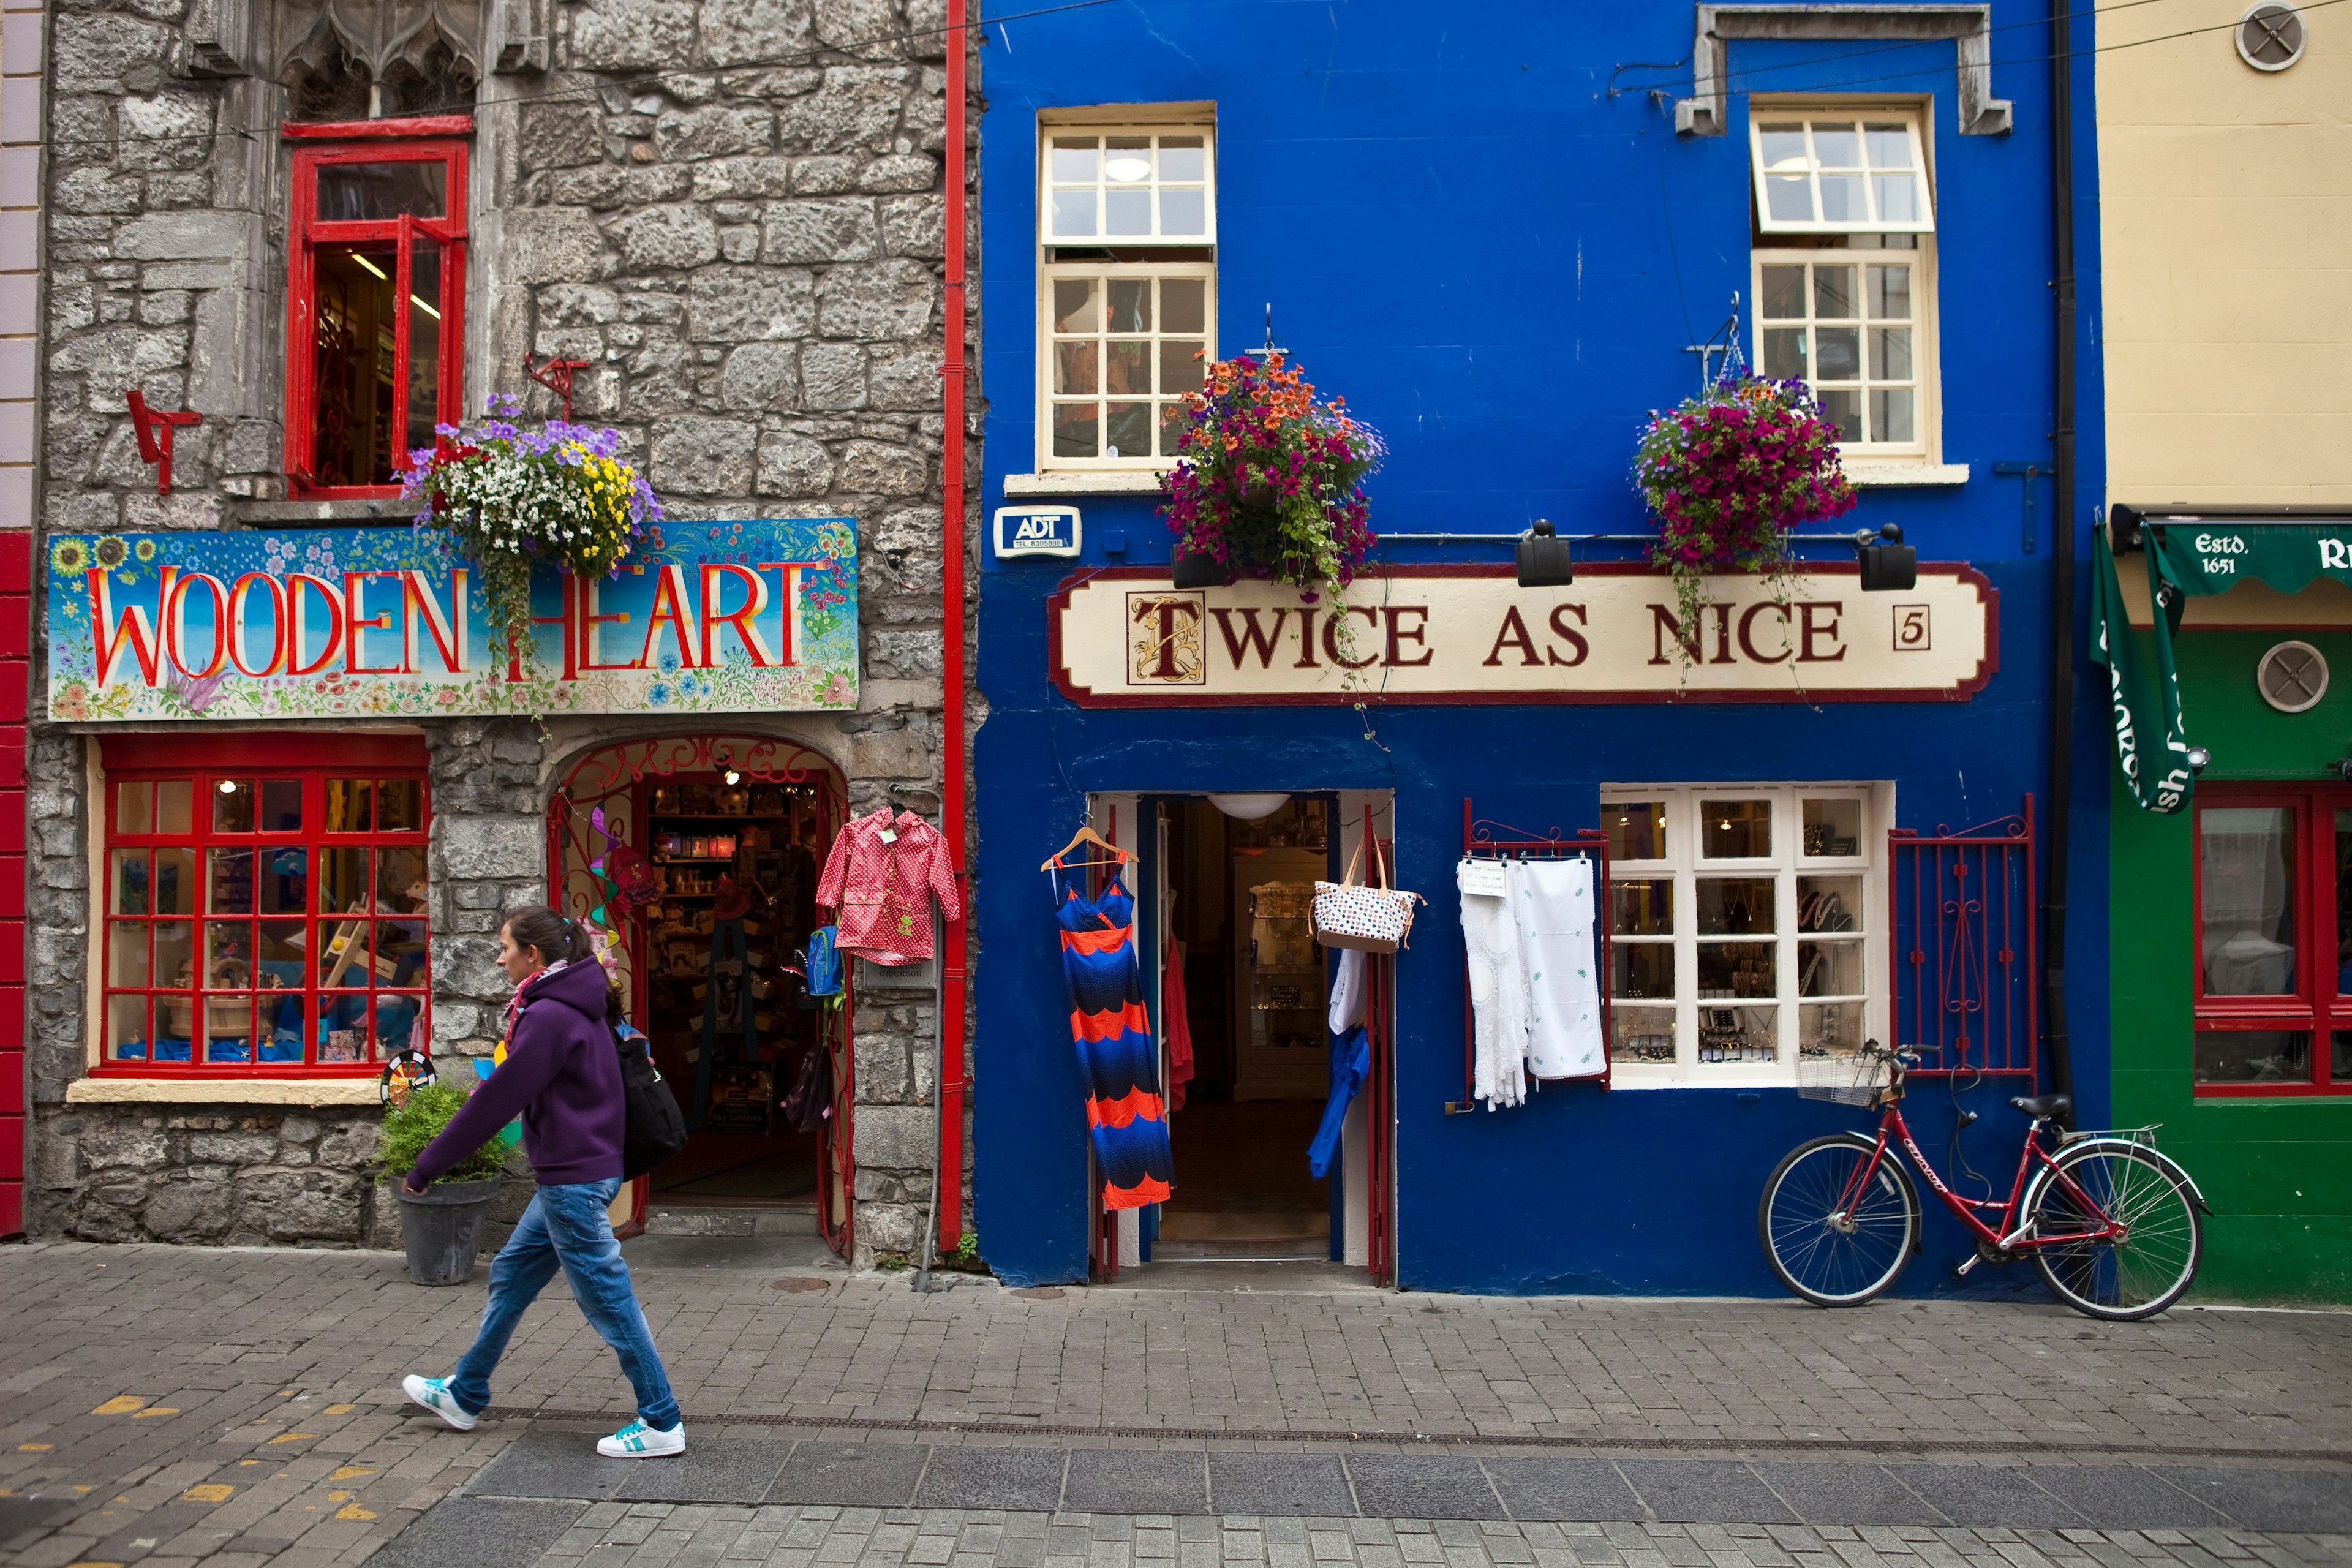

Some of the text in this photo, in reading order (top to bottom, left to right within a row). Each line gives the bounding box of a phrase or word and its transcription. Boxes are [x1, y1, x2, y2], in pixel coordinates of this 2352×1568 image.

[1015, 516, 1060, 539] ADT
[2195, 533, 2249, 554] Estd.
[2202, 557, 2236, 575] 1651
[86, 562, 835, 688] WOODEN HEART
[1133, 600, 1849, 678] TWICE AS NICE
[1901, 612, 1924, 644] 5
[1903, 1138, 1948, 1193] GIANT
